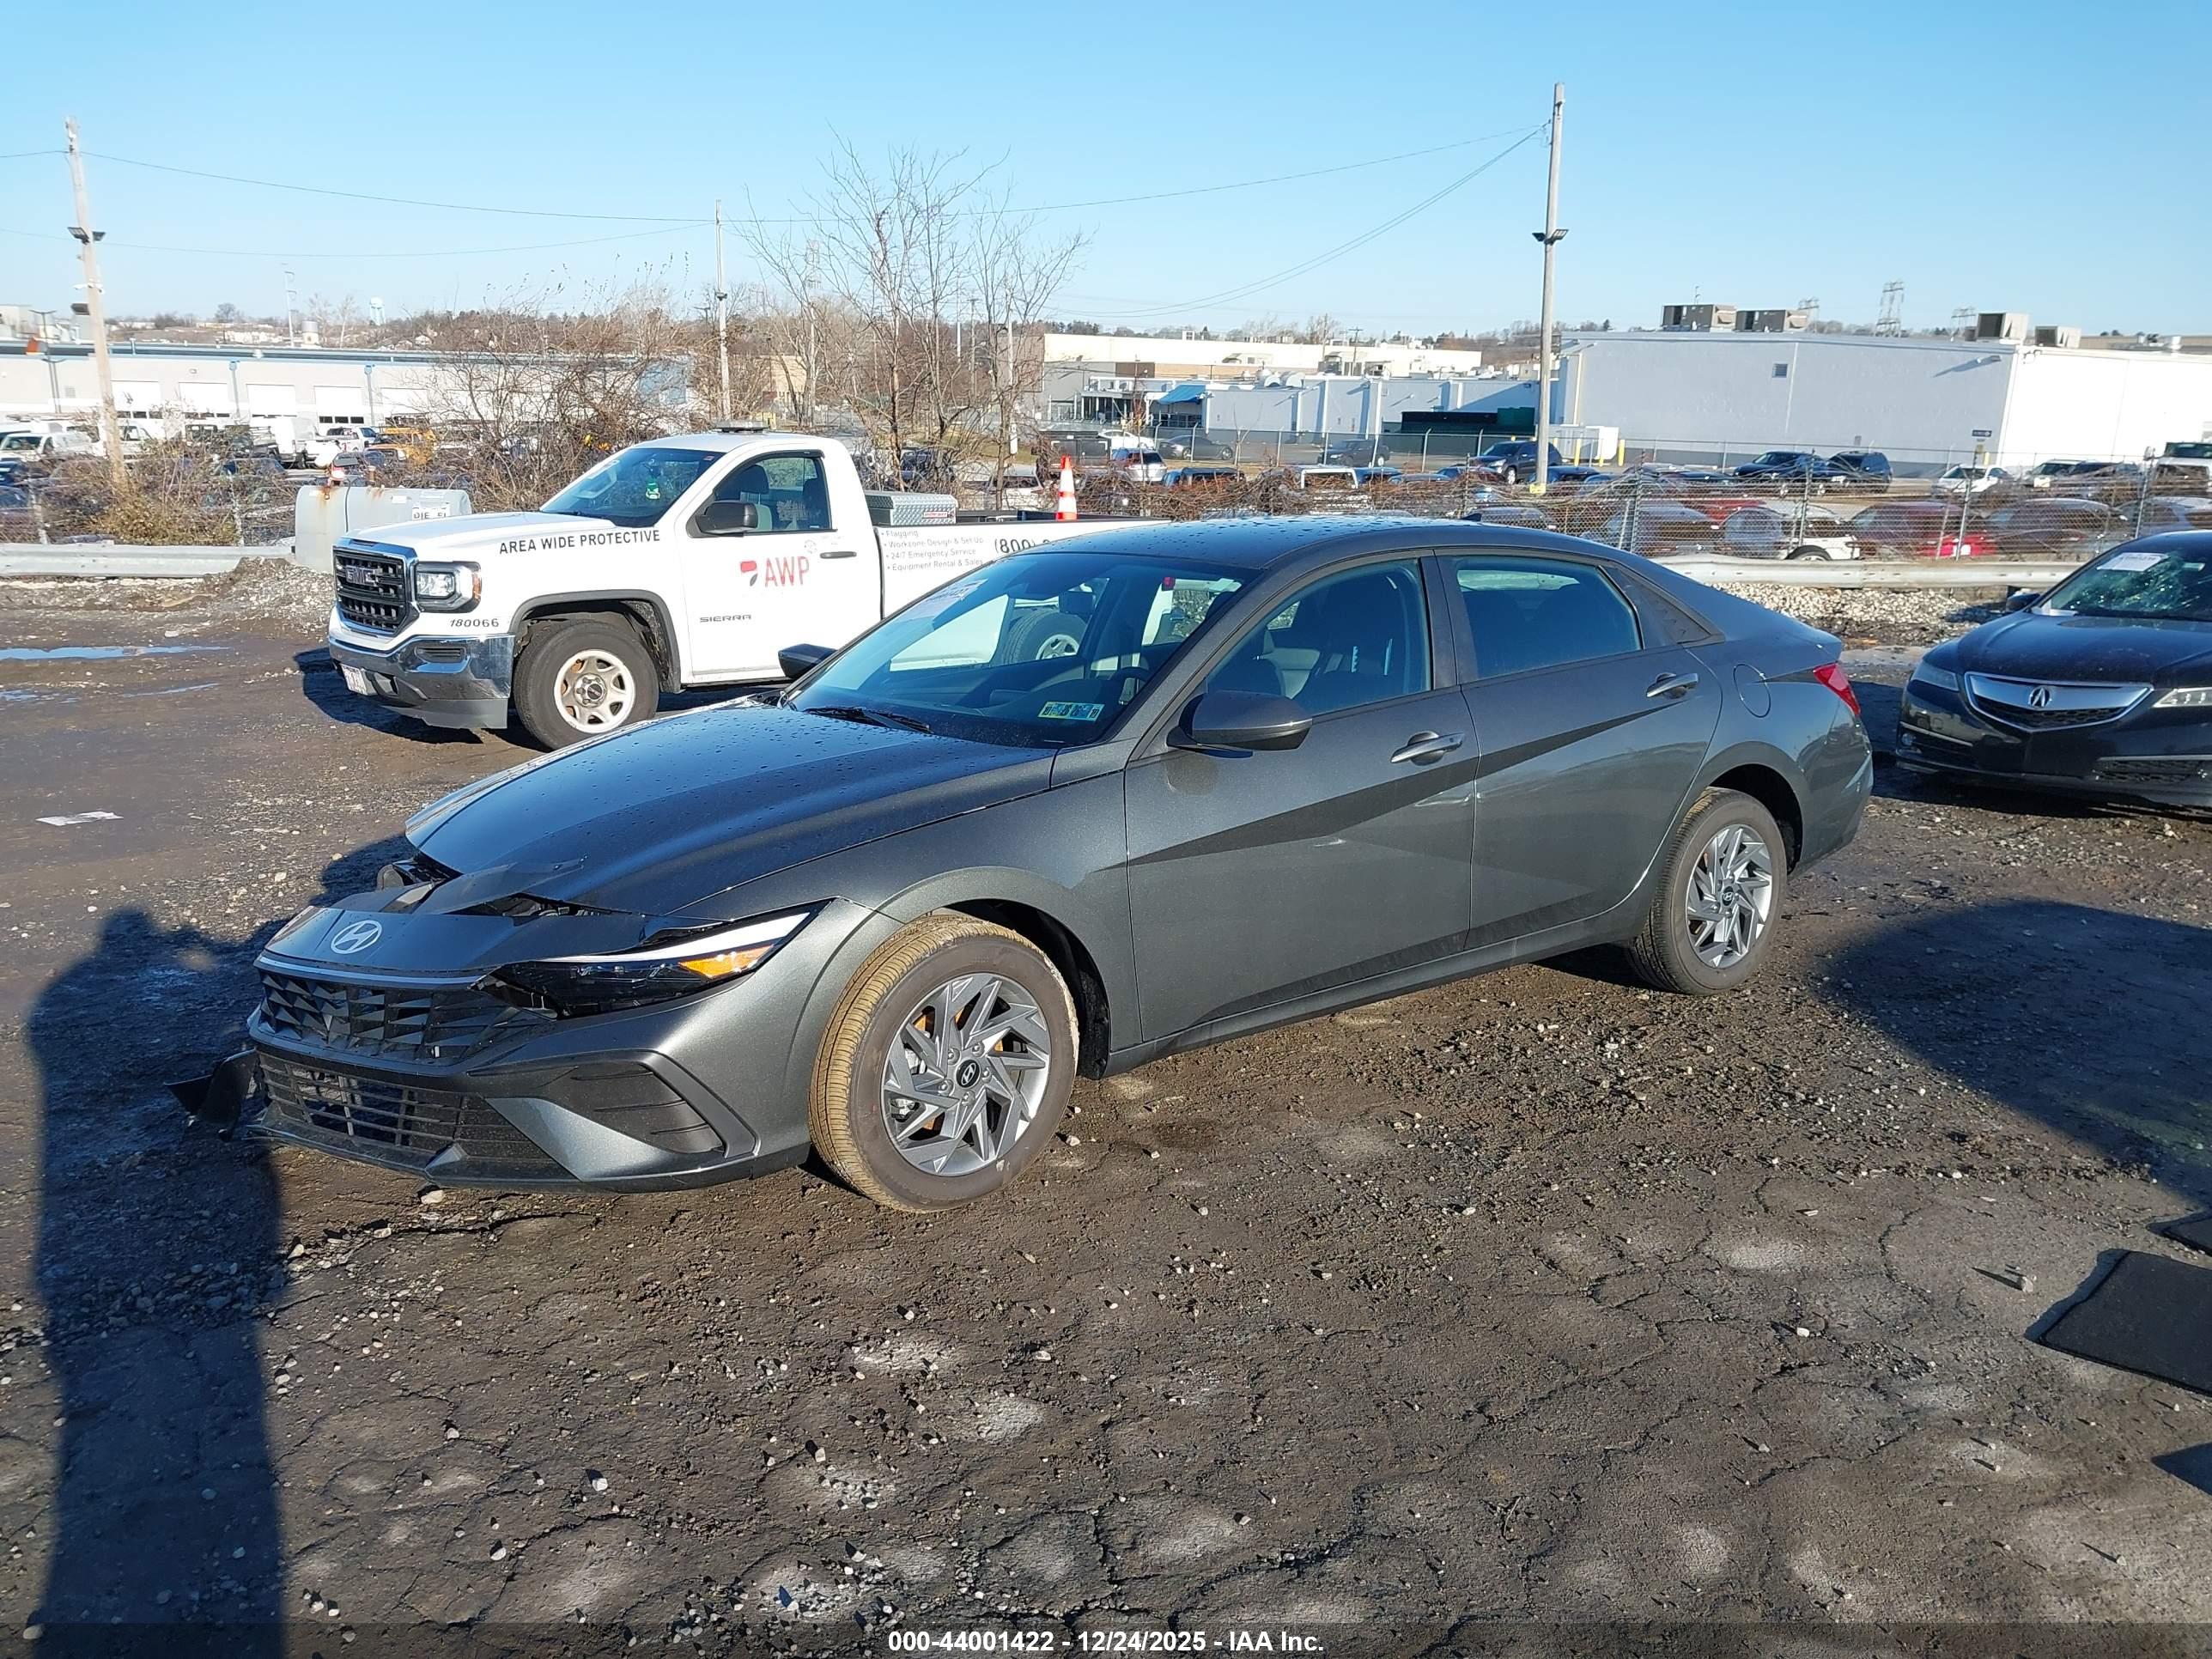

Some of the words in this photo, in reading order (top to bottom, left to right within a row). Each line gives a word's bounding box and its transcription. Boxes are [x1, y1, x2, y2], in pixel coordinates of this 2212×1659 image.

[885, 530, 919, 539] Flagging
[499, 538, 537, 555] AREA
[541, 536, 575, 550] WIDE
[580, 530, 660, 547] PROTECTIVE
[908, 550, 950, 559] Emergency
[951, 548, 976, 556] Service
[764, 556, 810, 587] AWP
[892, 562, 932, 572] Equipment
[933, 559, 956, 568] Rental
[346, 565, 379, 586] GMC
[450, 618, 500, 628] 180066
[700, 614, 751, 623] SIERRA
